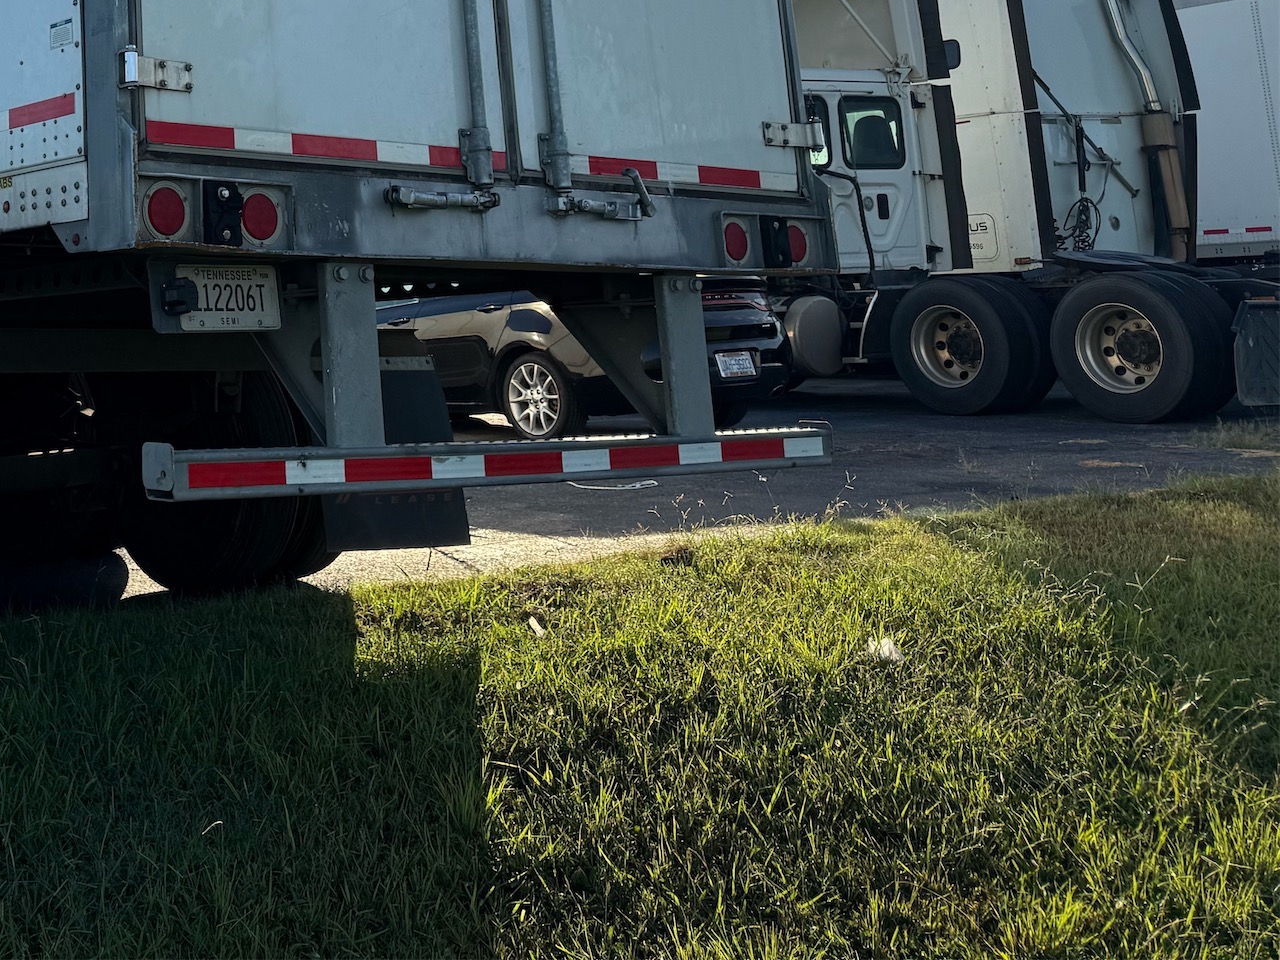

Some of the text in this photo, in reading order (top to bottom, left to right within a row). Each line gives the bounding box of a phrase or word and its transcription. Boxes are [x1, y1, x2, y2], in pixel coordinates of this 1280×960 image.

[200, 269, 253, 281] TENNESSEE
[193, 283, 264, 312] 12206T
[220, 317, 240, 326] SEMI
[375, 493, 453, 504] LEASE
